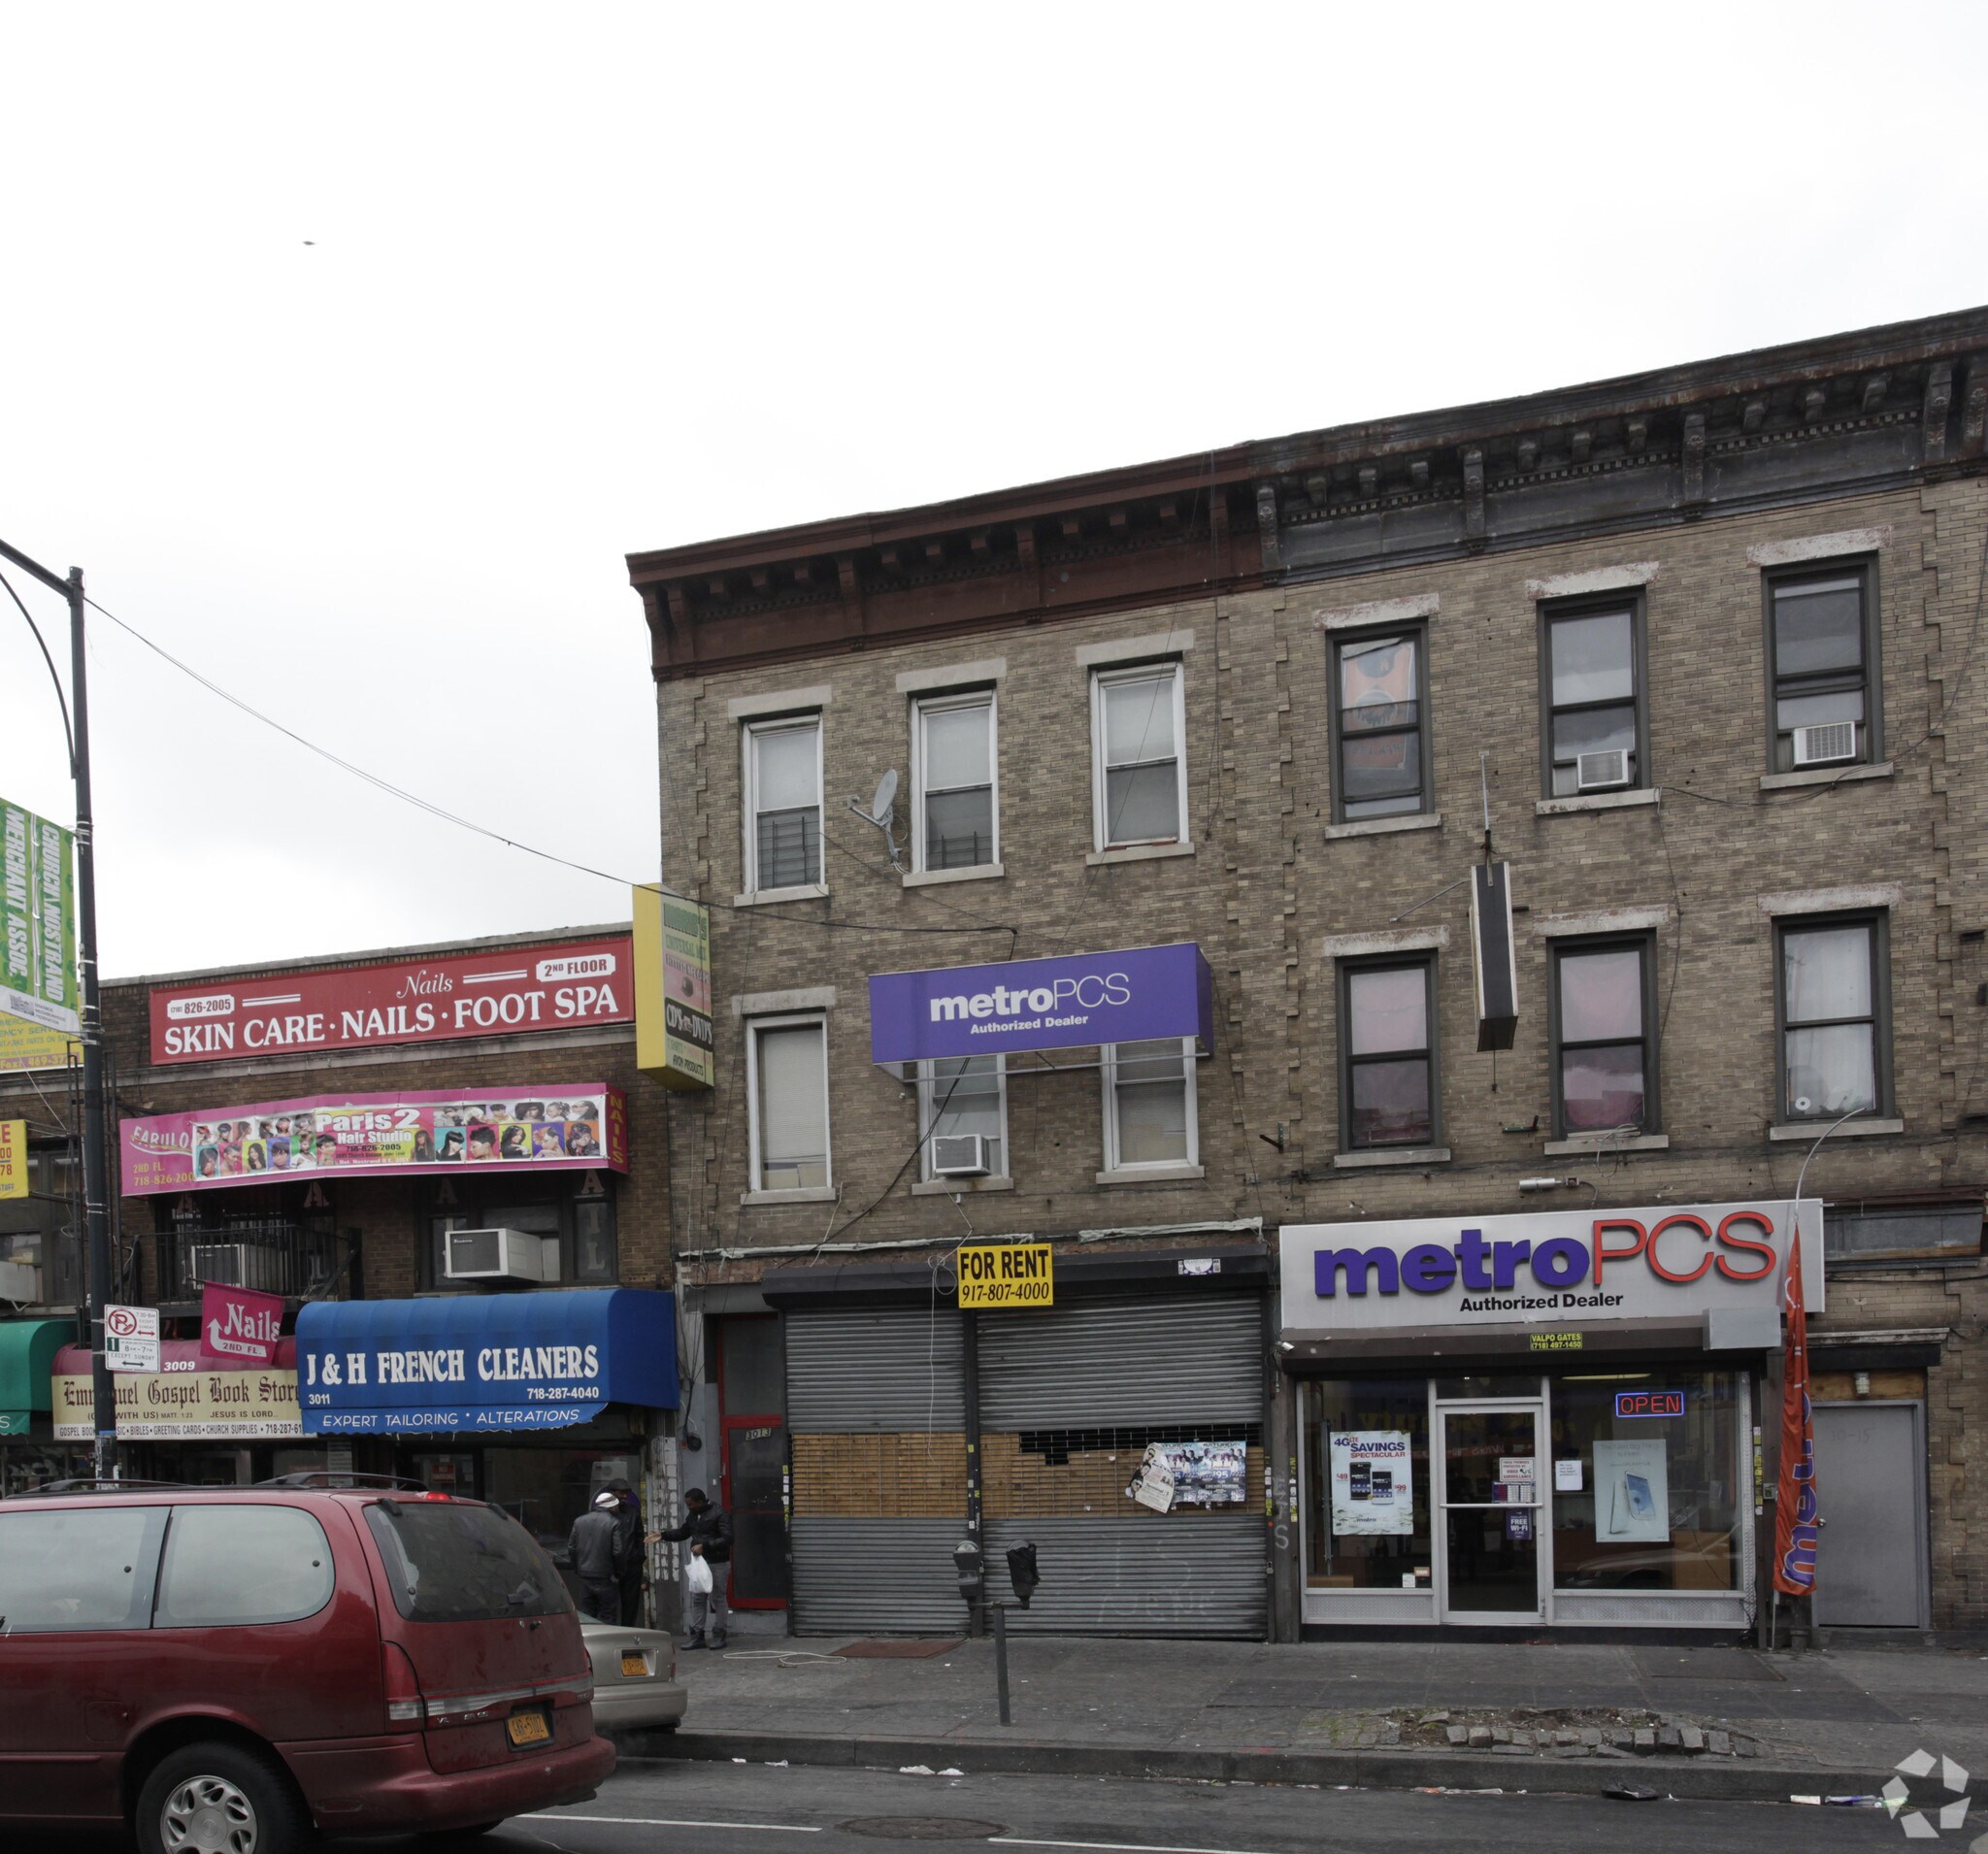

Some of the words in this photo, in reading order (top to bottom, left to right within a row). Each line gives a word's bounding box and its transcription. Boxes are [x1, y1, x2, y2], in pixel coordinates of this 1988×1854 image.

[5, 807, 27, 912] MERCHANT
[8, 912, 28, 977] ASSOC.
[545, 963, 564, 977] 2ND
[567, 958, 608, 976] FLOOR
[396, 970, 453, 999] Nails
[184, 998, 231, 1014] 826-2005
[930, 973, 1131, 1022] metroPCS
[164, 1021, 235, 1055] SKIN
[244, 1012, 325, 1047] CARE
[341, 1002, 436, 1039] NAILS
[454, 991, 546, 1029] FOOT
[554, 983, 618, 1018] SPA
[971, 1018, 1041, 1035] Authorized
[1045, 1013, 1089, 1028] Dealer
[337, 1132, 366, 1144] Hair
[368, 1130, 413, 1143] Studio
[610, 1094, 624, 1165] NAILS
[346, 1143, 402, 1152] 718-826-2005
[133, 1164, 149, 1174] 2ND
[1313, 1210, 1776, 1297] metroPCS
[960, 1251, 996, 1280] FOR
[1001, 1249, 1049, 1278] RENT
[962, 1281, 1049, 1302] 917-807-4000
[1459, 1294, 1558, 1312] Authorized
[1562, 1292, 1624, 1308] Dealer
[223, 1302, 281, 1342] Nails
[222, 1341, 243, 1352] 2ND
[1531, 1334, 1556, 1342] VALPO
[1557, 1333, 1581, 1341] GATES
[163, 1361, 195, 1372] 3009
[307, 1353, 316, 1385] J
[321, 1353, 343, 1385] &
[347, 1352, 367, 1384] H
[377, 1349, 465, 1384] FRENCH
[478, 1344, 600, 1382] CLEANERS
[148, 1378, 201, 1409] Gospel
[209, 1376, 250, 1405] Book
[309, 1393, 331, 1405] 3011
[527, 1386, 600, 1400] 718-287-4040
[1620, 1395, 1680, 1414] OPEN
[210, 1410, 237, 1419] JESUS
[322, 1414, 378, 1427] EXPERT
[385, 1412, 459, 1427] TAILORING
[477, 1409, 580, 1424] ALTERATIONS
[59, 1426, 81, 1437] GOSPEL
[130, 1425, 150, 1436] BIBLES
[153, 1424, 180, 1436] GREETING
[182, 1424, 201, 1436] CARDS
[206, 1424, 229, 1435] CHURCH
[231, 1424, 258, 1435] SUPPLIES
[746, 1428, 770, 1440] 3013
[1334, 1438, 1350, 1446] 4G
[1350, 1441, 1406, 1452] SAVINGS
